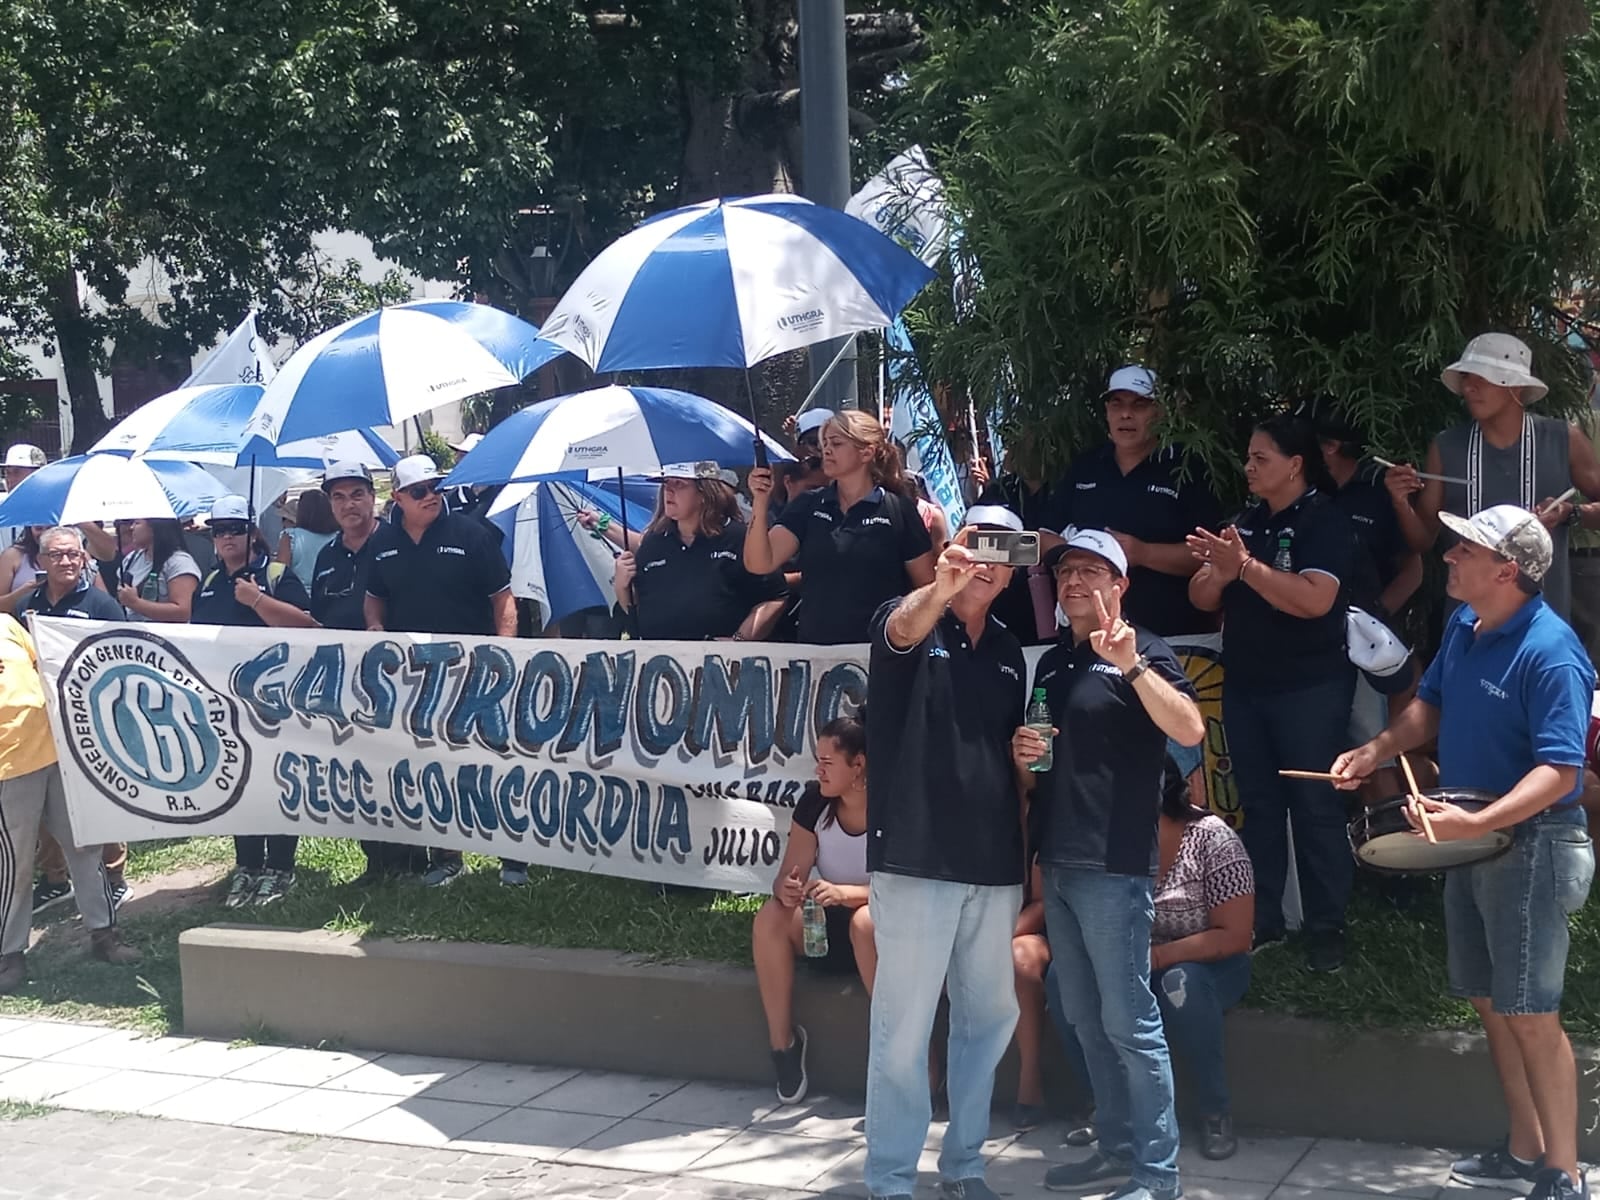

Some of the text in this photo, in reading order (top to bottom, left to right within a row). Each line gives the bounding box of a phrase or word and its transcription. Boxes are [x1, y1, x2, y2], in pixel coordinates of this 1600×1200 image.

[787, 309, 824, 324] UTHGRA
[96, 644, 168, 673] GENERAL
[69, 655, 139, 799] CONFEDERACION
[208, 694, 239, 791] TRABAJO
[703, 827, 780, 866] JULIO
